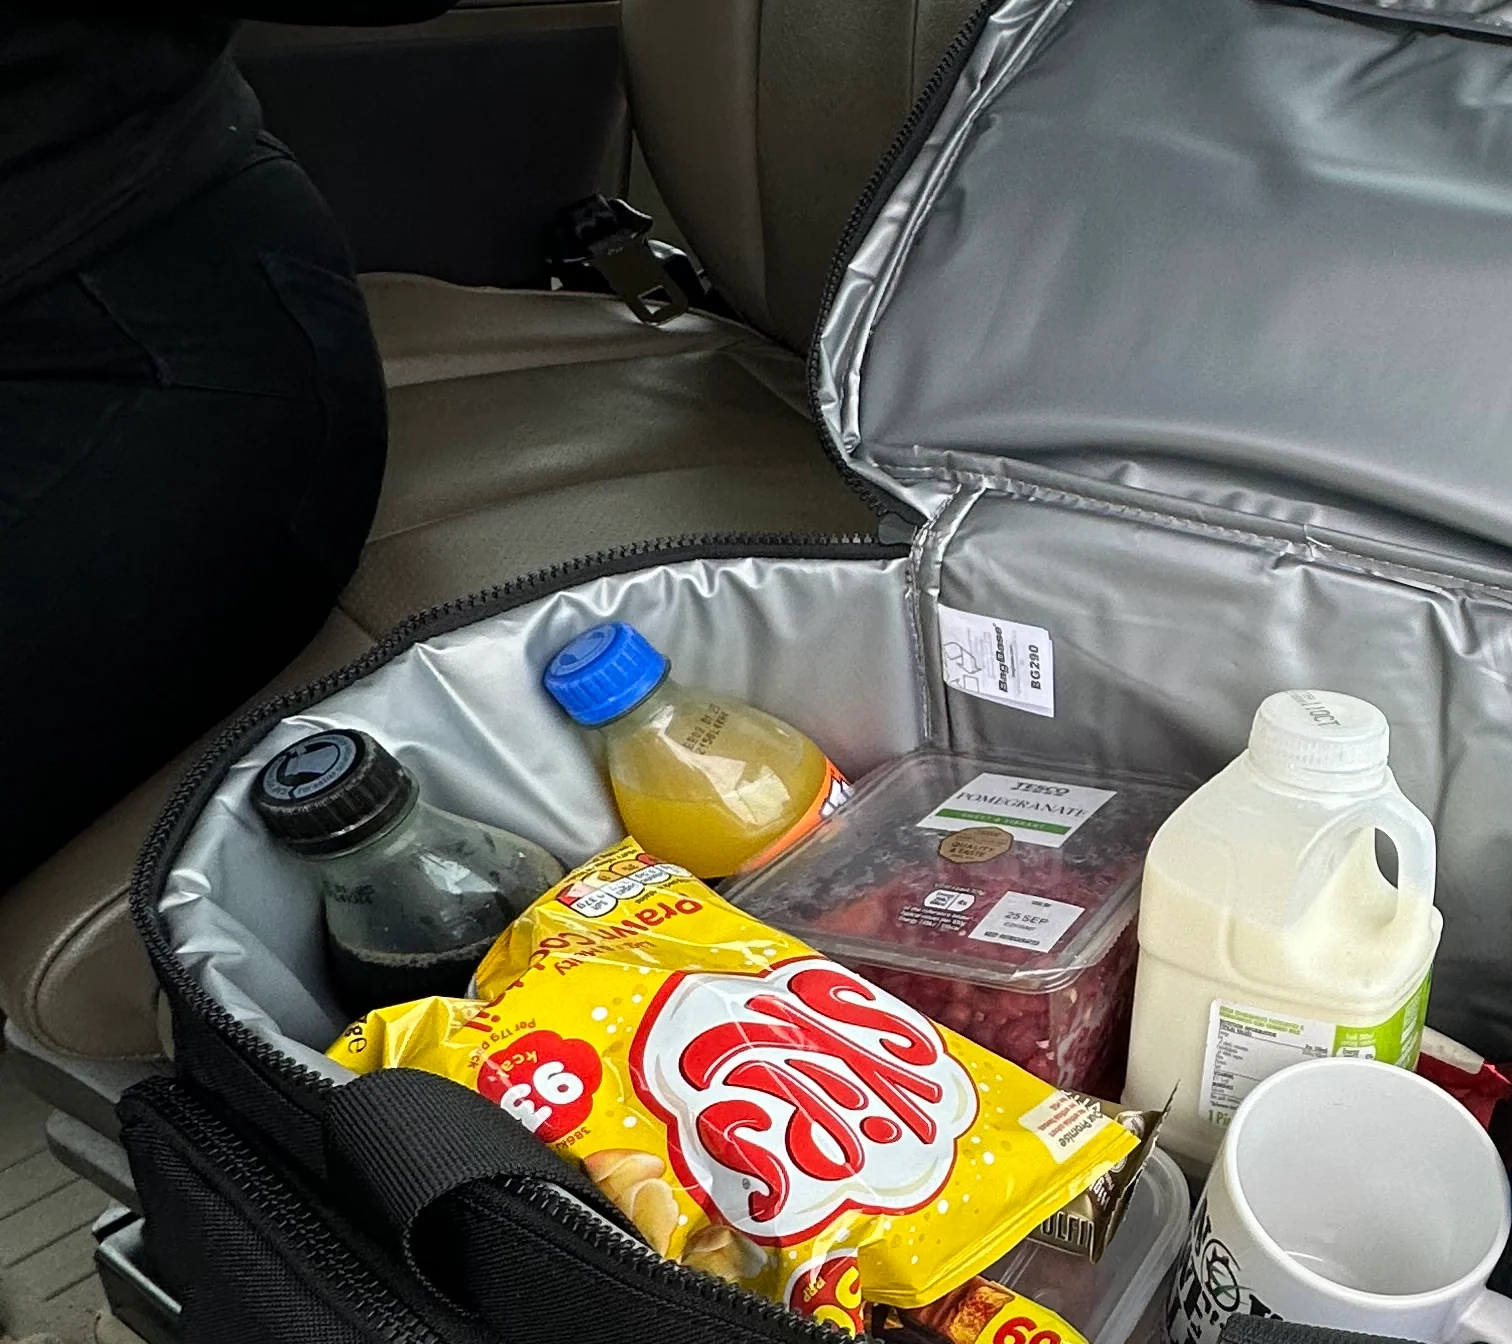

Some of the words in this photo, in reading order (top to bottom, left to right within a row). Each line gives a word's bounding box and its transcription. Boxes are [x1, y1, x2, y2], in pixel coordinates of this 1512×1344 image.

[1029, 644, 1043, 691] BG290
[1010, 780, 1070, 797] TESCO
[955, 791, 1088, 817] POMEGRANATE
[497, 1050, 539, 1080] kcal
